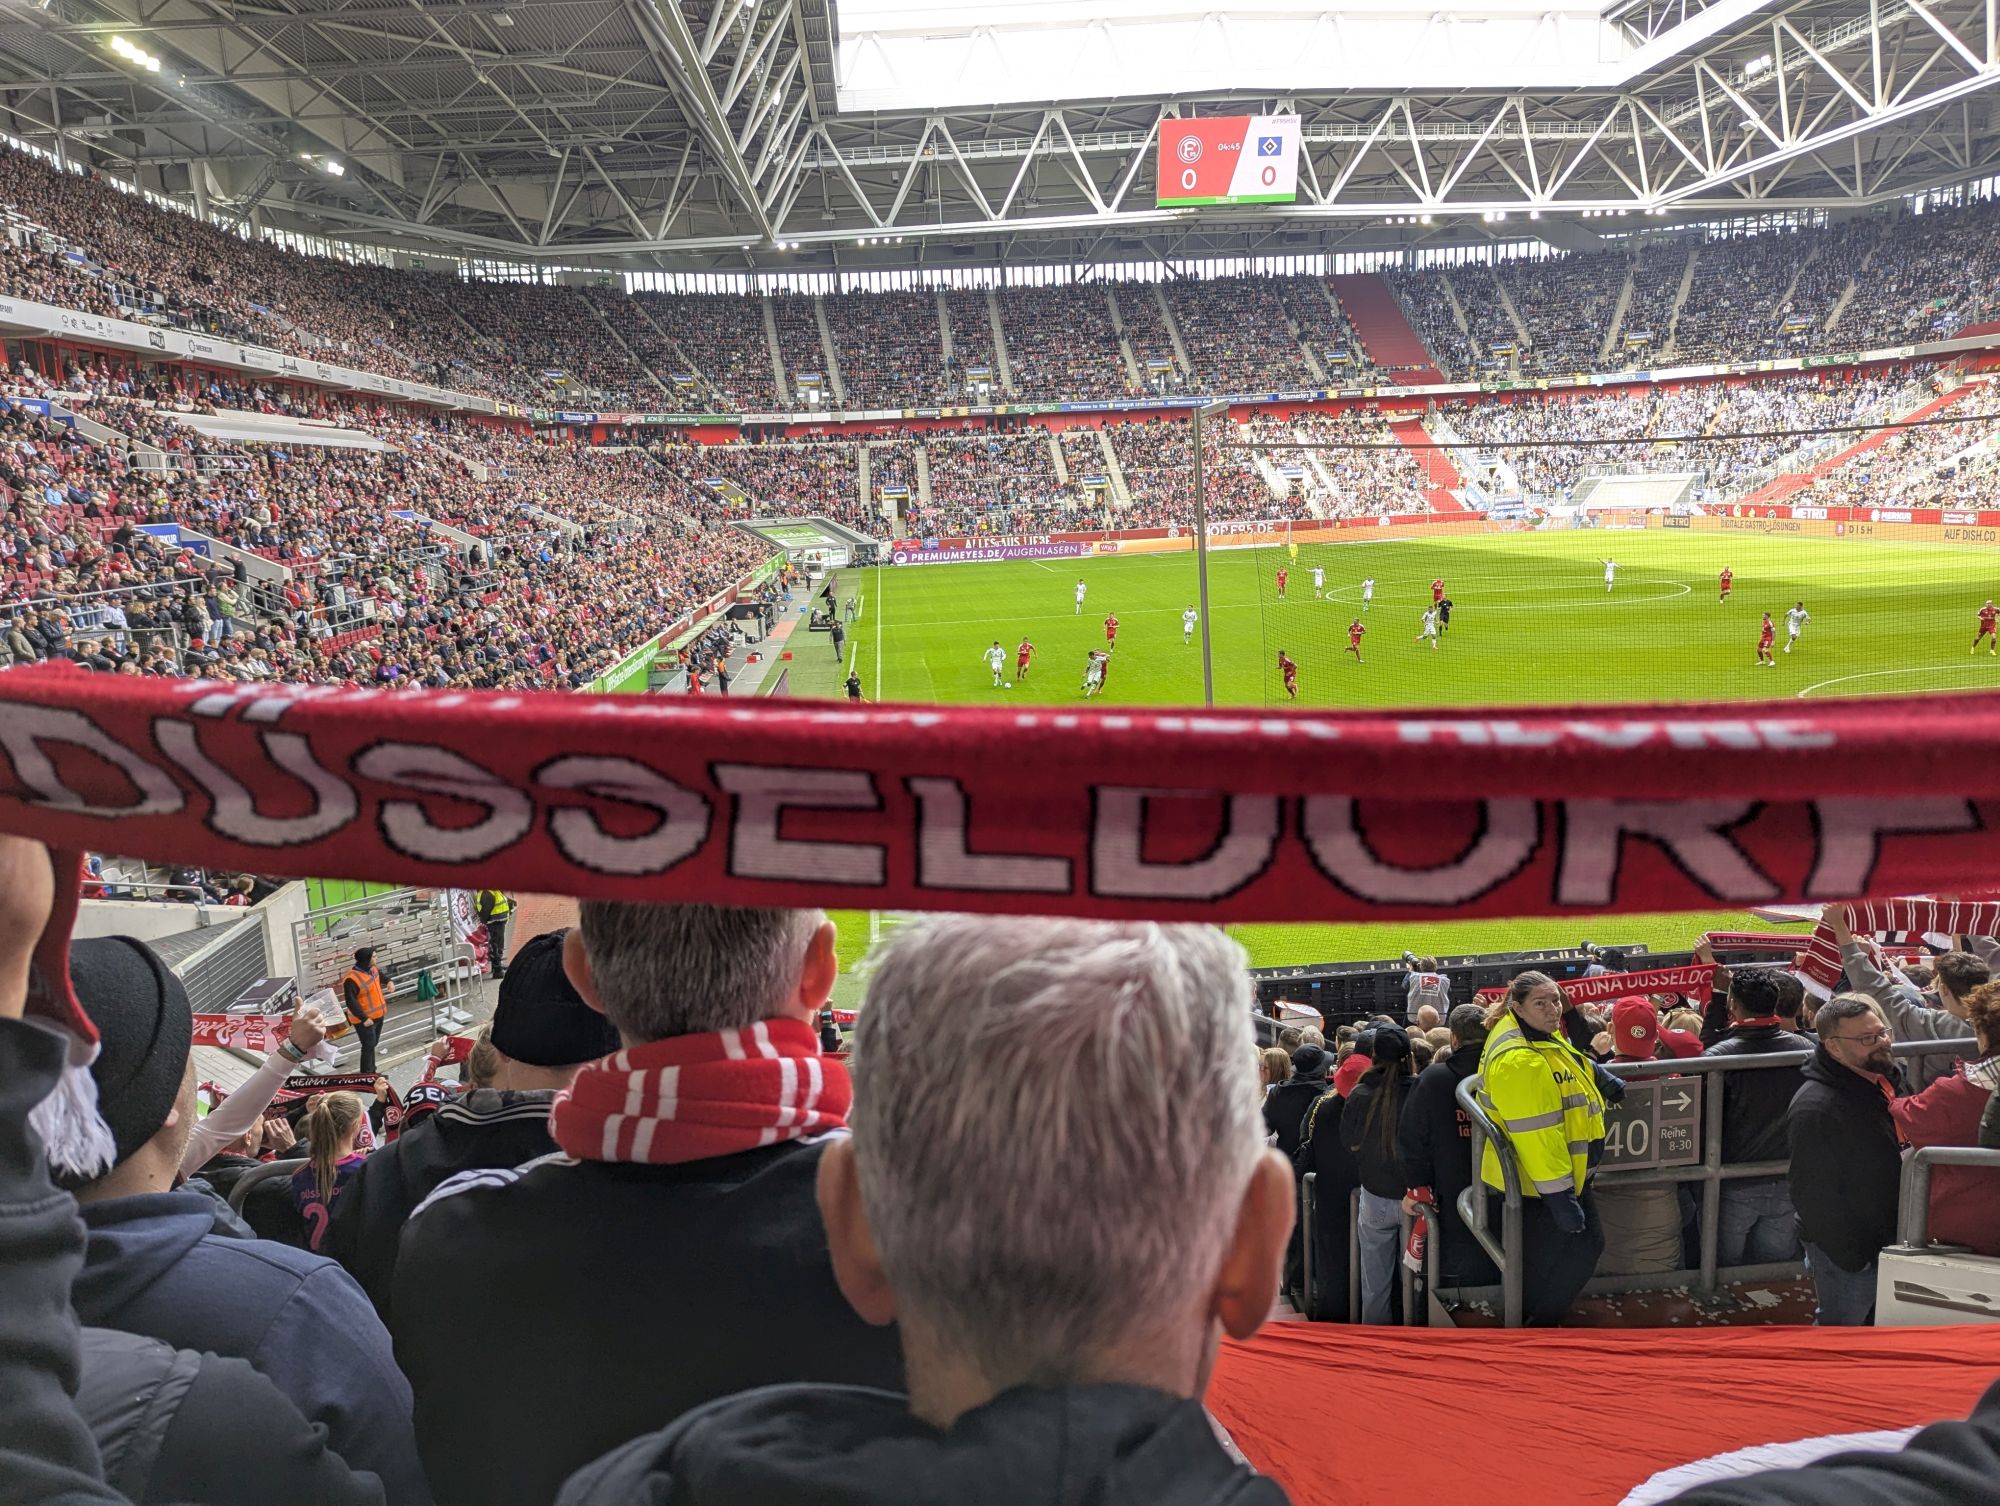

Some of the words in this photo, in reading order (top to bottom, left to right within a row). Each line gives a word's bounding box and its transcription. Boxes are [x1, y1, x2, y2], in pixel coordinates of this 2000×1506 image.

[1217, 143, 1241, 151] 04:45
[1181, 169, 1197, 190] 0
[1261, 165, 1277, 186] 0
[1791, 507, 1828, 519] METRO
[1881, 511, 1912, 522] MERKUR
[1665, 516, 1689, 527] METRO
[1720, 519, 1744, 529] DIGITALE
[1849, 525, 1873, 535] DISH
[1944, 529, 1960, 541] AUF
[1962, 529, 1996, 542] DISH.CO
[1604, 1118, 1649, 1158] 40
[1661, 1127, 1688, 1139] Reihe
[1668, 1139, 1692, 1151] 8-30
